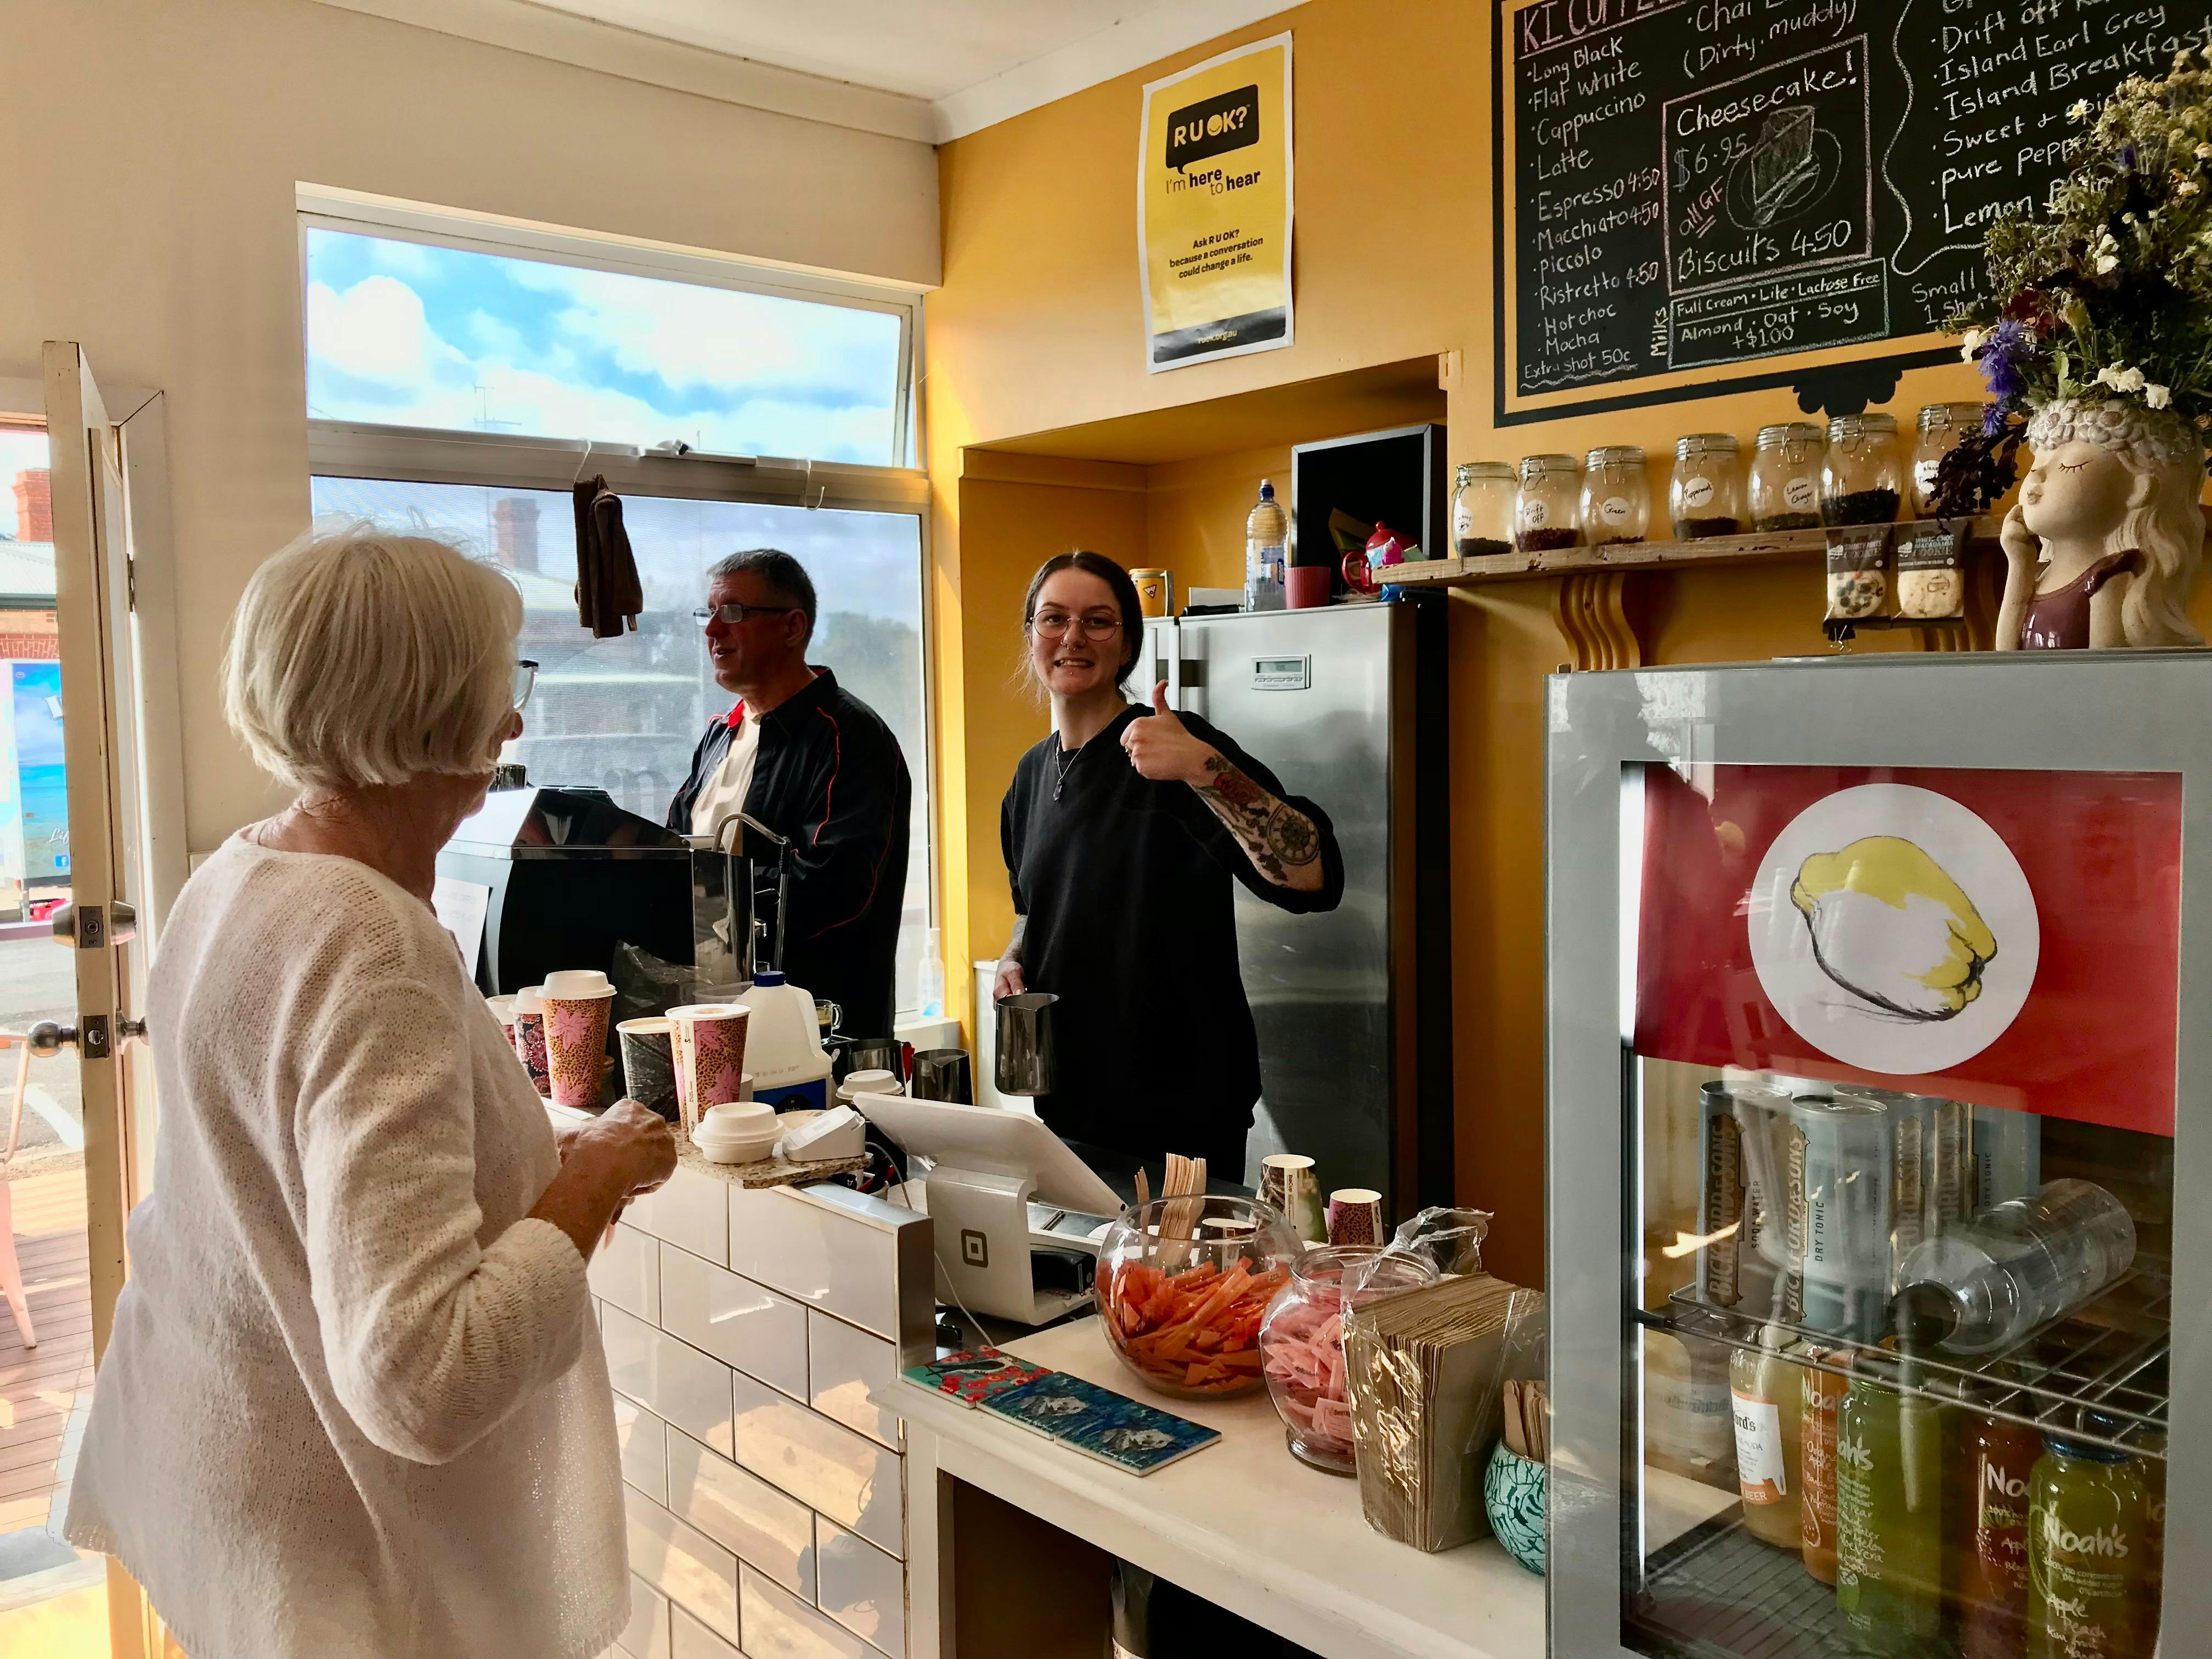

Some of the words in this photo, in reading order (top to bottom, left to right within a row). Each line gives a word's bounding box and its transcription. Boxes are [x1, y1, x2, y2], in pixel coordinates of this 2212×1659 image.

[1523, 1, 1564, 53] KI
[1940, 38, 2028, 86] Island
[2036, 21, 2090, 58] Earl
[2105, 5, 2166, 35] Grey
[1943, 10, 2007, 54] Drift
[1533, 62, 1570, 84] Long
[1573, 36, 1623, 69] Black
[1943, 71, 2038, 121] Island
[2049, 15, 2212, 91] Breakfast
[1533, 80, 1570, 111] Flat
[1677, 50, 1858, 136] Cheesecake!
[1174, 122, 1186, 148] R
[1190, 118, 1203, 143] U
[1206, 105, 1249, 137] OK?
[1537, 92, 1646, 147] Cappuccino
[1943, 115, 2026, 157] Sweet
[1166, 178, 1186, 194] I'm
[1189, 168, 1222, 188] here
[1210, 181, 1223, 196] to
[1226, 171, 1261, 191] hear
[1538, 149, 1594, 180] Latte
[1537, 210, 1629, 251] Macchiato
[1944, 195, 2033, 234] Lemon
[1170, 253, 1203, 268] because
[1210, 237, 1264, 259] conversation
[1193, 238, 1207, 250] Ask
[1209, 236, 1215, 245] R
[1215, 233, 1222, 244] U
[1223, 229, 1240, 242] OK?
[1678, 232, 1780, 282] Biscuits
[1179, 265, 1200, 279] could
[1201, 259, 1229, 274] change
[1237, 253, 1253, 264] life.
[1911, 266, 1975, 303] Small
[1540, 272, 1620, 311] Ristretto
[1677, 301, 1702, 316] Full
[1706, 294, 1748, 310] Cream
[1760, 284, 1788, 302] Lite
[1798, 277, 1848, 297] Lactose
[1853, 272, 1880, 285] Free
[1544, 313, 1576, 337] Hot
[1681, 316, 1743, 342] Almond
[1764, 306, 1799, 328] Oat
[1818, 301, 1859, 324] Soy
[1546, 332, 1600, 356] Mocha
[1525, 360, 1560, 379] Extra
[1815, 1201, 1825, 1235] TONIC
[1815, 1239, 1824, 1262] DRY
[2044, 1514, 2129, 1558] Noah's
